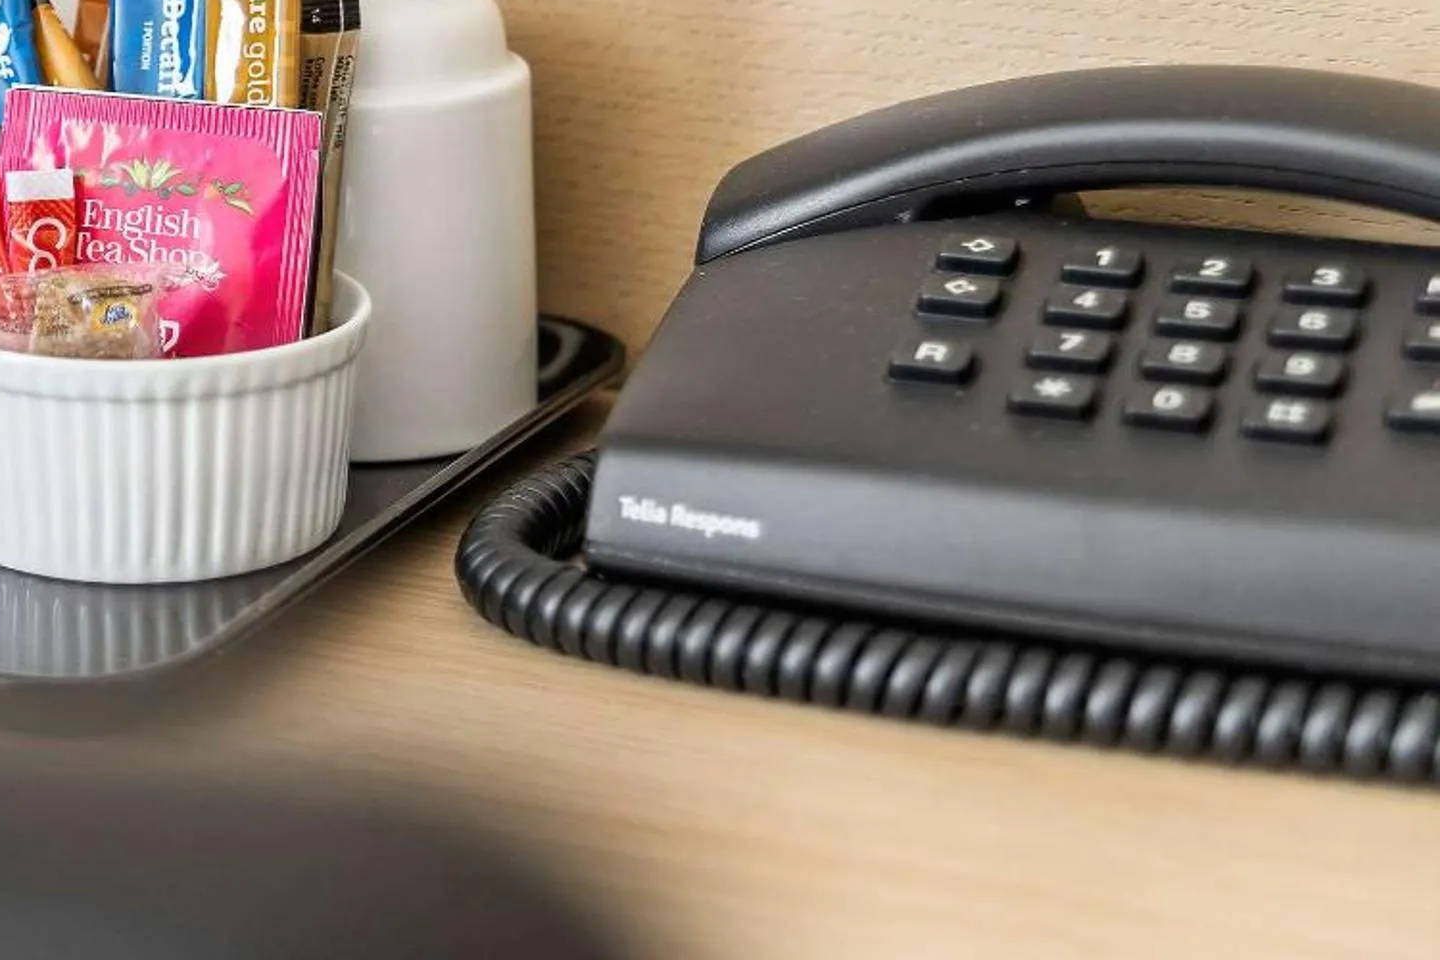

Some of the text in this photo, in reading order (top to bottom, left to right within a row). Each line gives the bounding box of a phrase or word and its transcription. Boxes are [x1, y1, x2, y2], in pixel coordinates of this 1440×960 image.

[244, 42, 272, 107] gold
[82, 198, 201, 240] English
[1095, 249, 1113, 267] 1
[1199, 258, 1229, 277] 2
[1311, 267, 1342, 286] 3
[1073, 291, 1099, 309] 4
[1184, 301, 1213, 320] 5
[1298, 311, 1330, 331] 6
[1060, 333, 1086, 351] 7
[914, 343, 948, 363] R
[1167, 344, 1200, 364] 8
[1285, 356, 1316, 376] 9
[1152, 390, 1184, 410] 0
